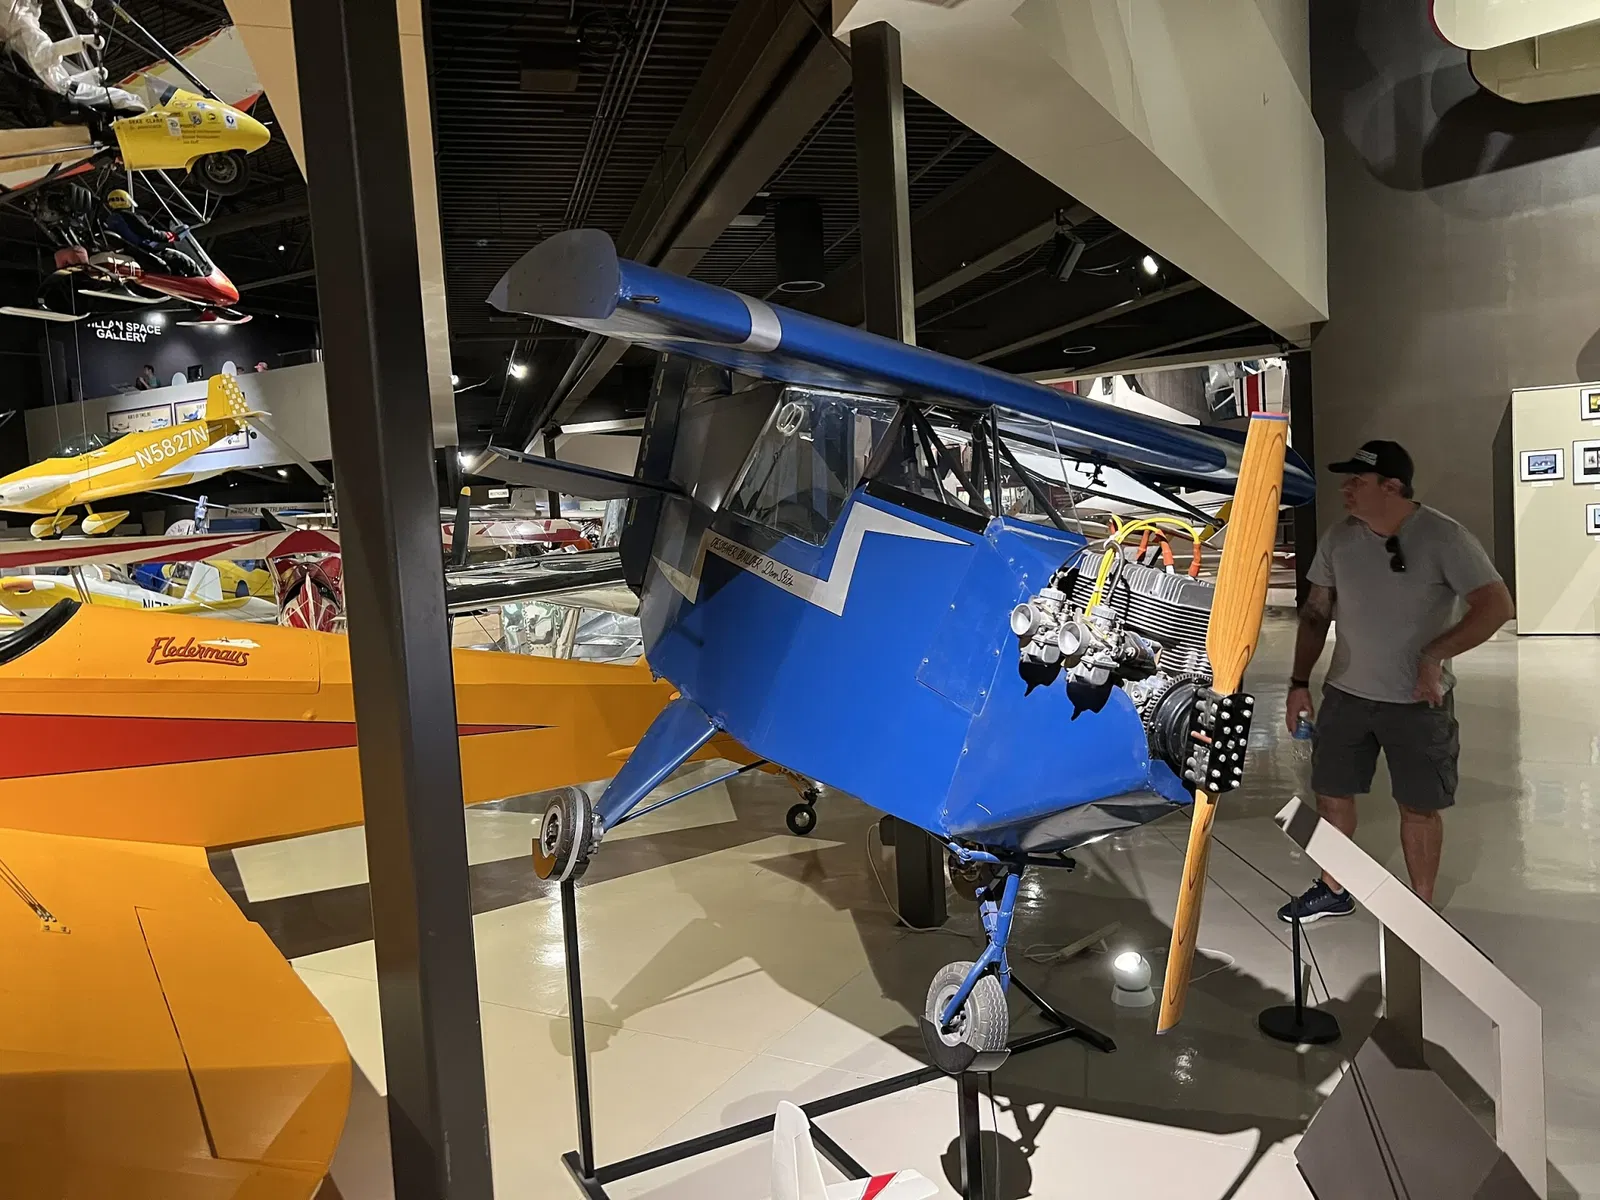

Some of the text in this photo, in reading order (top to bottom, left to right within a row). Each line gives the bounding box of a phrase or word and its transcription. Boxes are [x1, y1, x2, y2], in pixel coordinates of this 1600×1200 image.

[96, 328, 148, 342] GALLERY
[126, 322, 162, 335] SPACE
[135, 425, 209, 469] N5827N
[147, 636, 250, 666] Fledermaus
